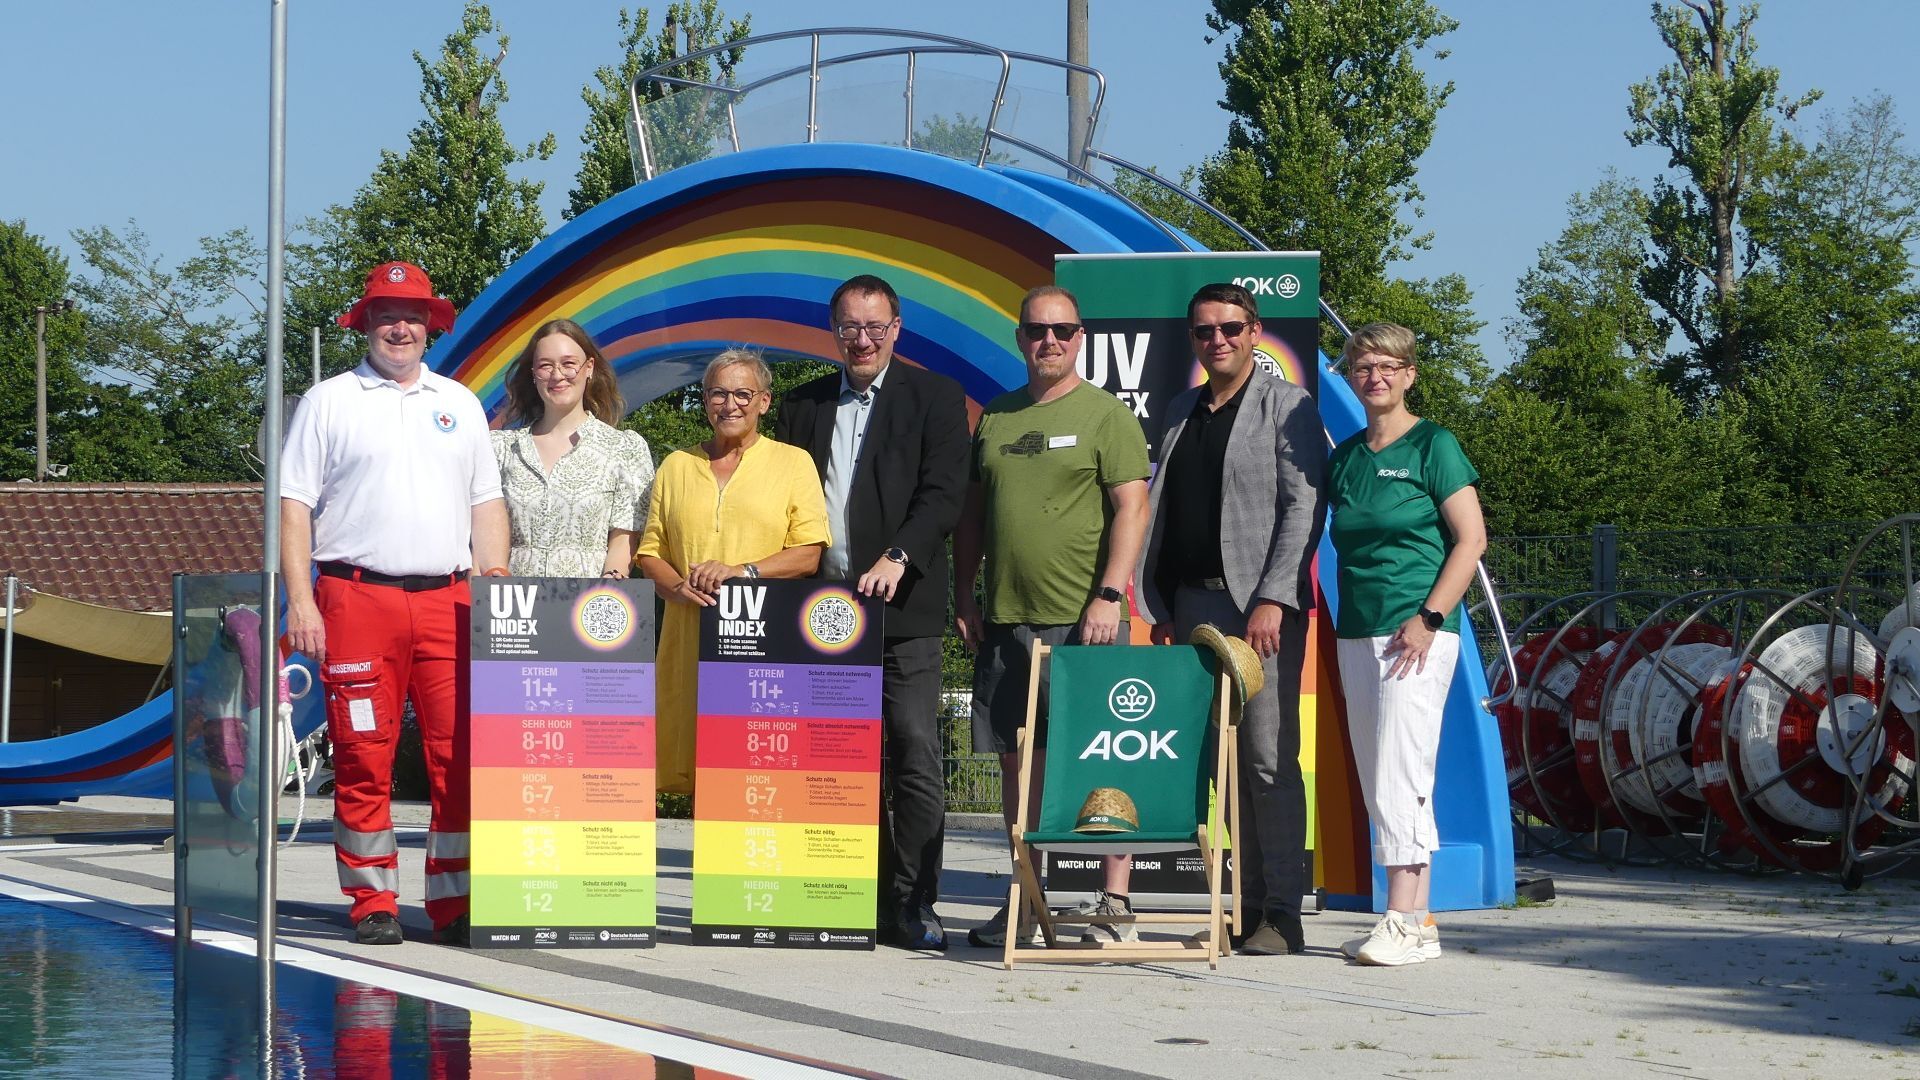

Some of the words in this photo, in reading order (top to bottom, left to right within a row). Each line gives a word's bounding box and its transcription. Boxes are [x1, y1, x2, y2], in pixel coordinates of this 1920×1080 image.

[1075, 333, 1151, 389] UV
[1376, 469, 1398, 477] AOK
[491, 585, 537, 618] UV
[720, 586, 767, 619] UV
[491, 619, 538, 635] INDEX
[719, 620, 766, 637] INDEX
[329, 662, 371, 674] WASSERWACHT
[522, 667, 557, 676] EXTREM
[749, 669, 784, 678] EXTREM
[522, 678, 557, 696] 11+
[749, 680, 783, 698] 11+
[522, 720, 545, 728] SEHR
[548, 720, 572, 728] HOCH
[747, 722, 770, 730] SEHR
[773, 722, 797, 731] HOCH
[522, 732, 564, 750] 8-10
[747, 734, 788, 752] 8-10
[1079, 730, 1179, 761] AOK
[522, 774, 546, 782] HOCH
[746, 775, 770, 784] HOCH
[522, 785, 553, 804] 6-7
[746, 787, 777, 805] 6-7
[745, 827, 776, 837] MITTEL
[522, 839, 555, 857] 3-5
[745, 840, 776, 858] 3-5
[1058, 860, 1085, 869] WATCH
[1086, 861, 1101, 869] OUT
[1135, 861, 1160, 870] BEACH
[522, 880, 558, 889] NIEDRIG
[744, 881, 779, 890] NIEDRIG
[523, 893, 552, 912] 1-2
[744, 894, 773, 912] 1-2
